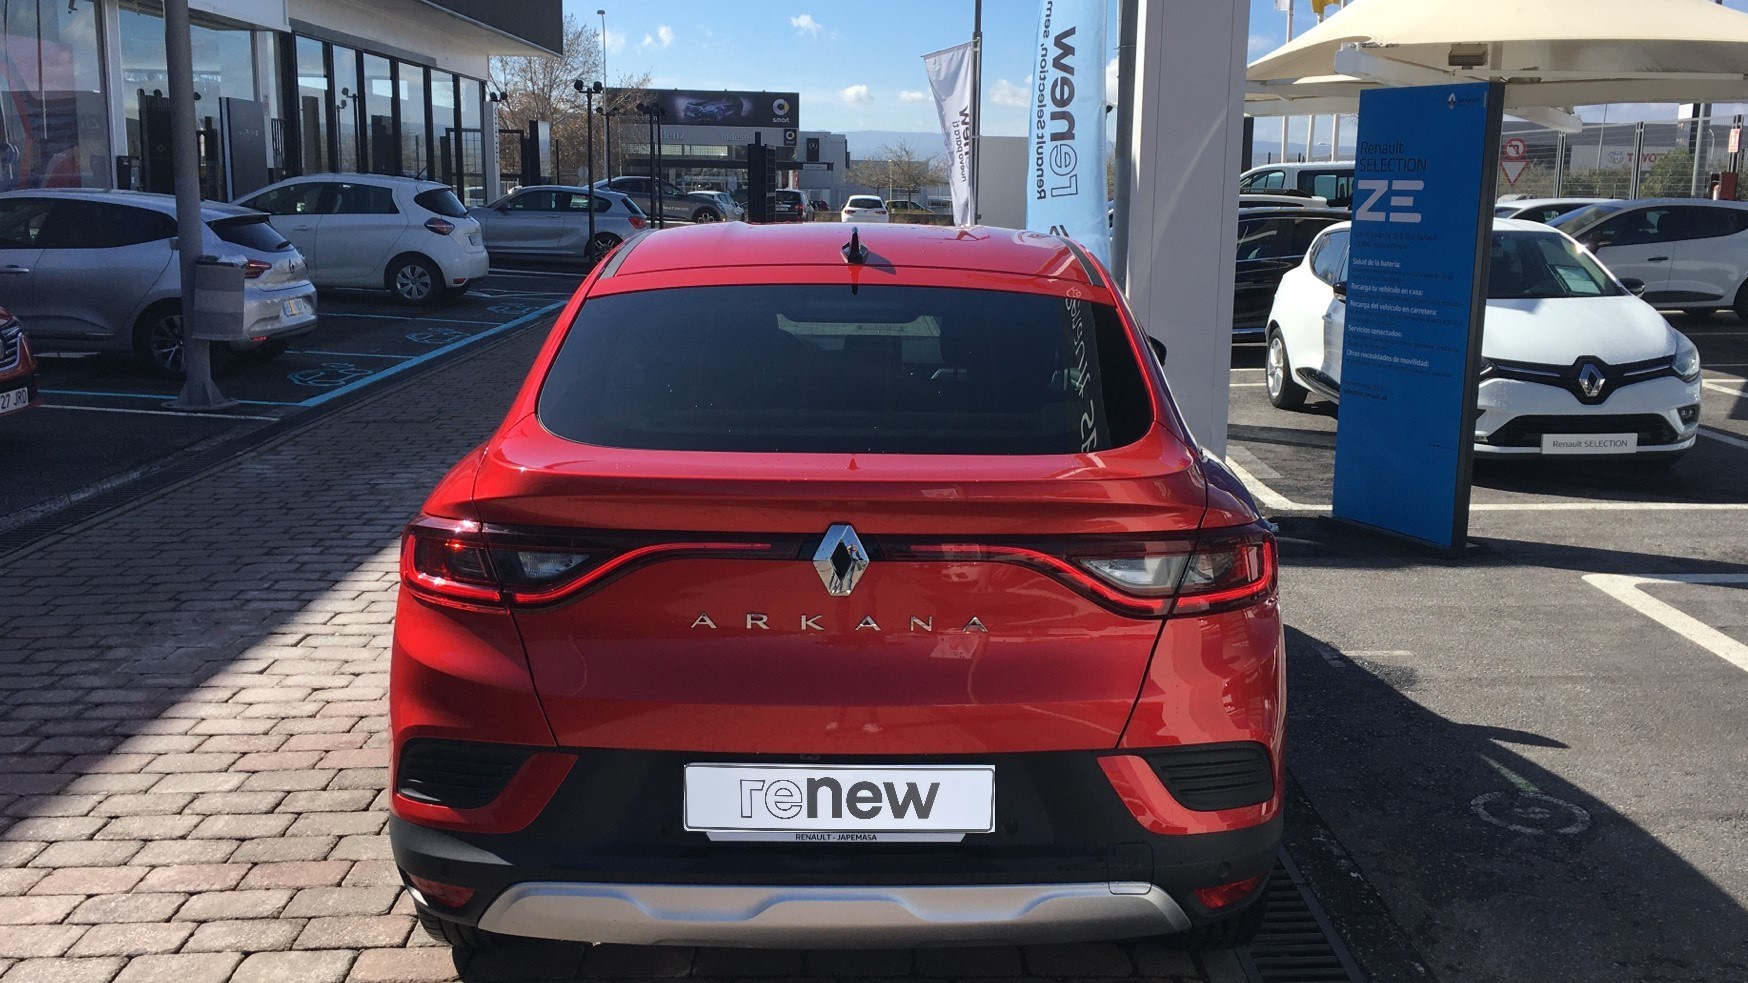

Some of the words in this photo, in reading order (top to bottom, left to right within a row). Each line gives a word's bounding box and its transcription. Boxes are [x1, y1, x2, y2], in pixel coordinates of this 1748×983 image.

[1360, 140, 1404, 154] Renault
[1359, 157, 1427, 172] SELECTION
[1352, 257, 1367, 265] Salud
[1351, 282, 1371, 292] Recarga
[1350, 299, 1370, 310] Recarga
[1410, 307, 1438, 316] carretera:
[1348, 324, 1371, 334] Servicios
[1371, 328, 1402, 337] conectados:
[1346, 349, 1360, 357] Otras
[1361, 352, 1392, 362] necesidades
[1400, 357, 1429, 367] movilidad:
[1552, 440, 1583, 448] Renault
[1584, 439, 1628, 448] SELECTION
[690, 612, 988, 634] ARKANA
[740, 776, 941, 820] renew
[795, 833, 832, 841] RENAULT
[836, 833, 878, 841] JAPEMASA
